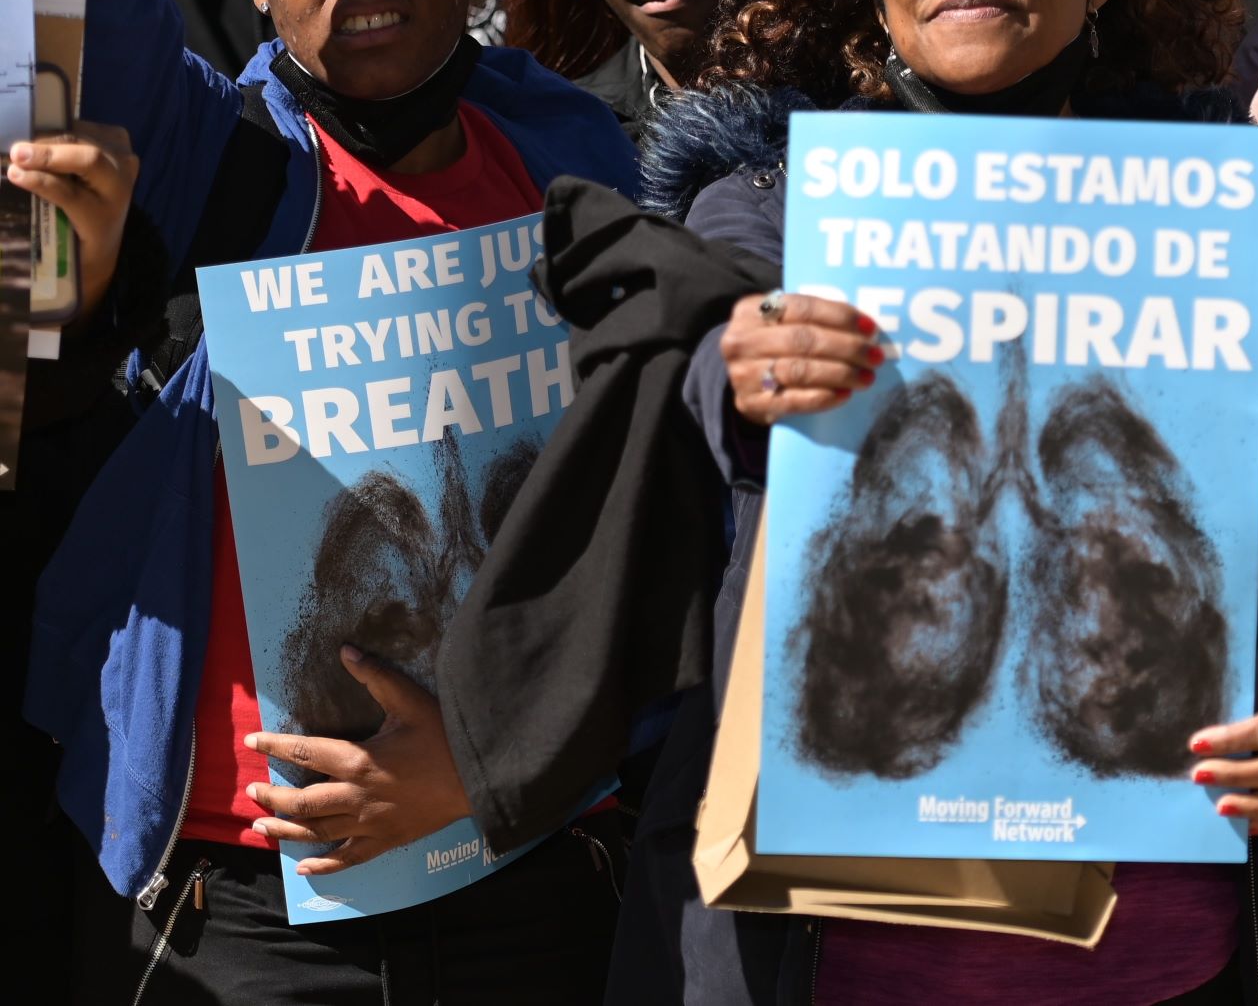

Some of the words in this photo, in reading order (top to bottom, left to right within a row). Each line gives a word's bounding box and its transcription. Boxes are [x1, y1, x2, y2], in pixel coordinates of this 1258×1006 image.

[802, 146, 958, 200] SOLO
[975, 152, 1256, 209] ESTAMOS
[240, 261, 328, 312] WE
[358, 241, 464, 299] ARE
[818, 217, 1137, 276] TRATANDO
[1153, 229, 1231, 279] DE
[284, 302, 492, 372] TRYING
[797, 285, 1253, 372] ESPIRAR
[237, 340, 575, 466] BREATH
[918, 796, 989, 821] Moving
[994, 797, 1072, 819] Forward
[993, 819, 1074, 842] Network
[426, 838, 480, 870] Moving
